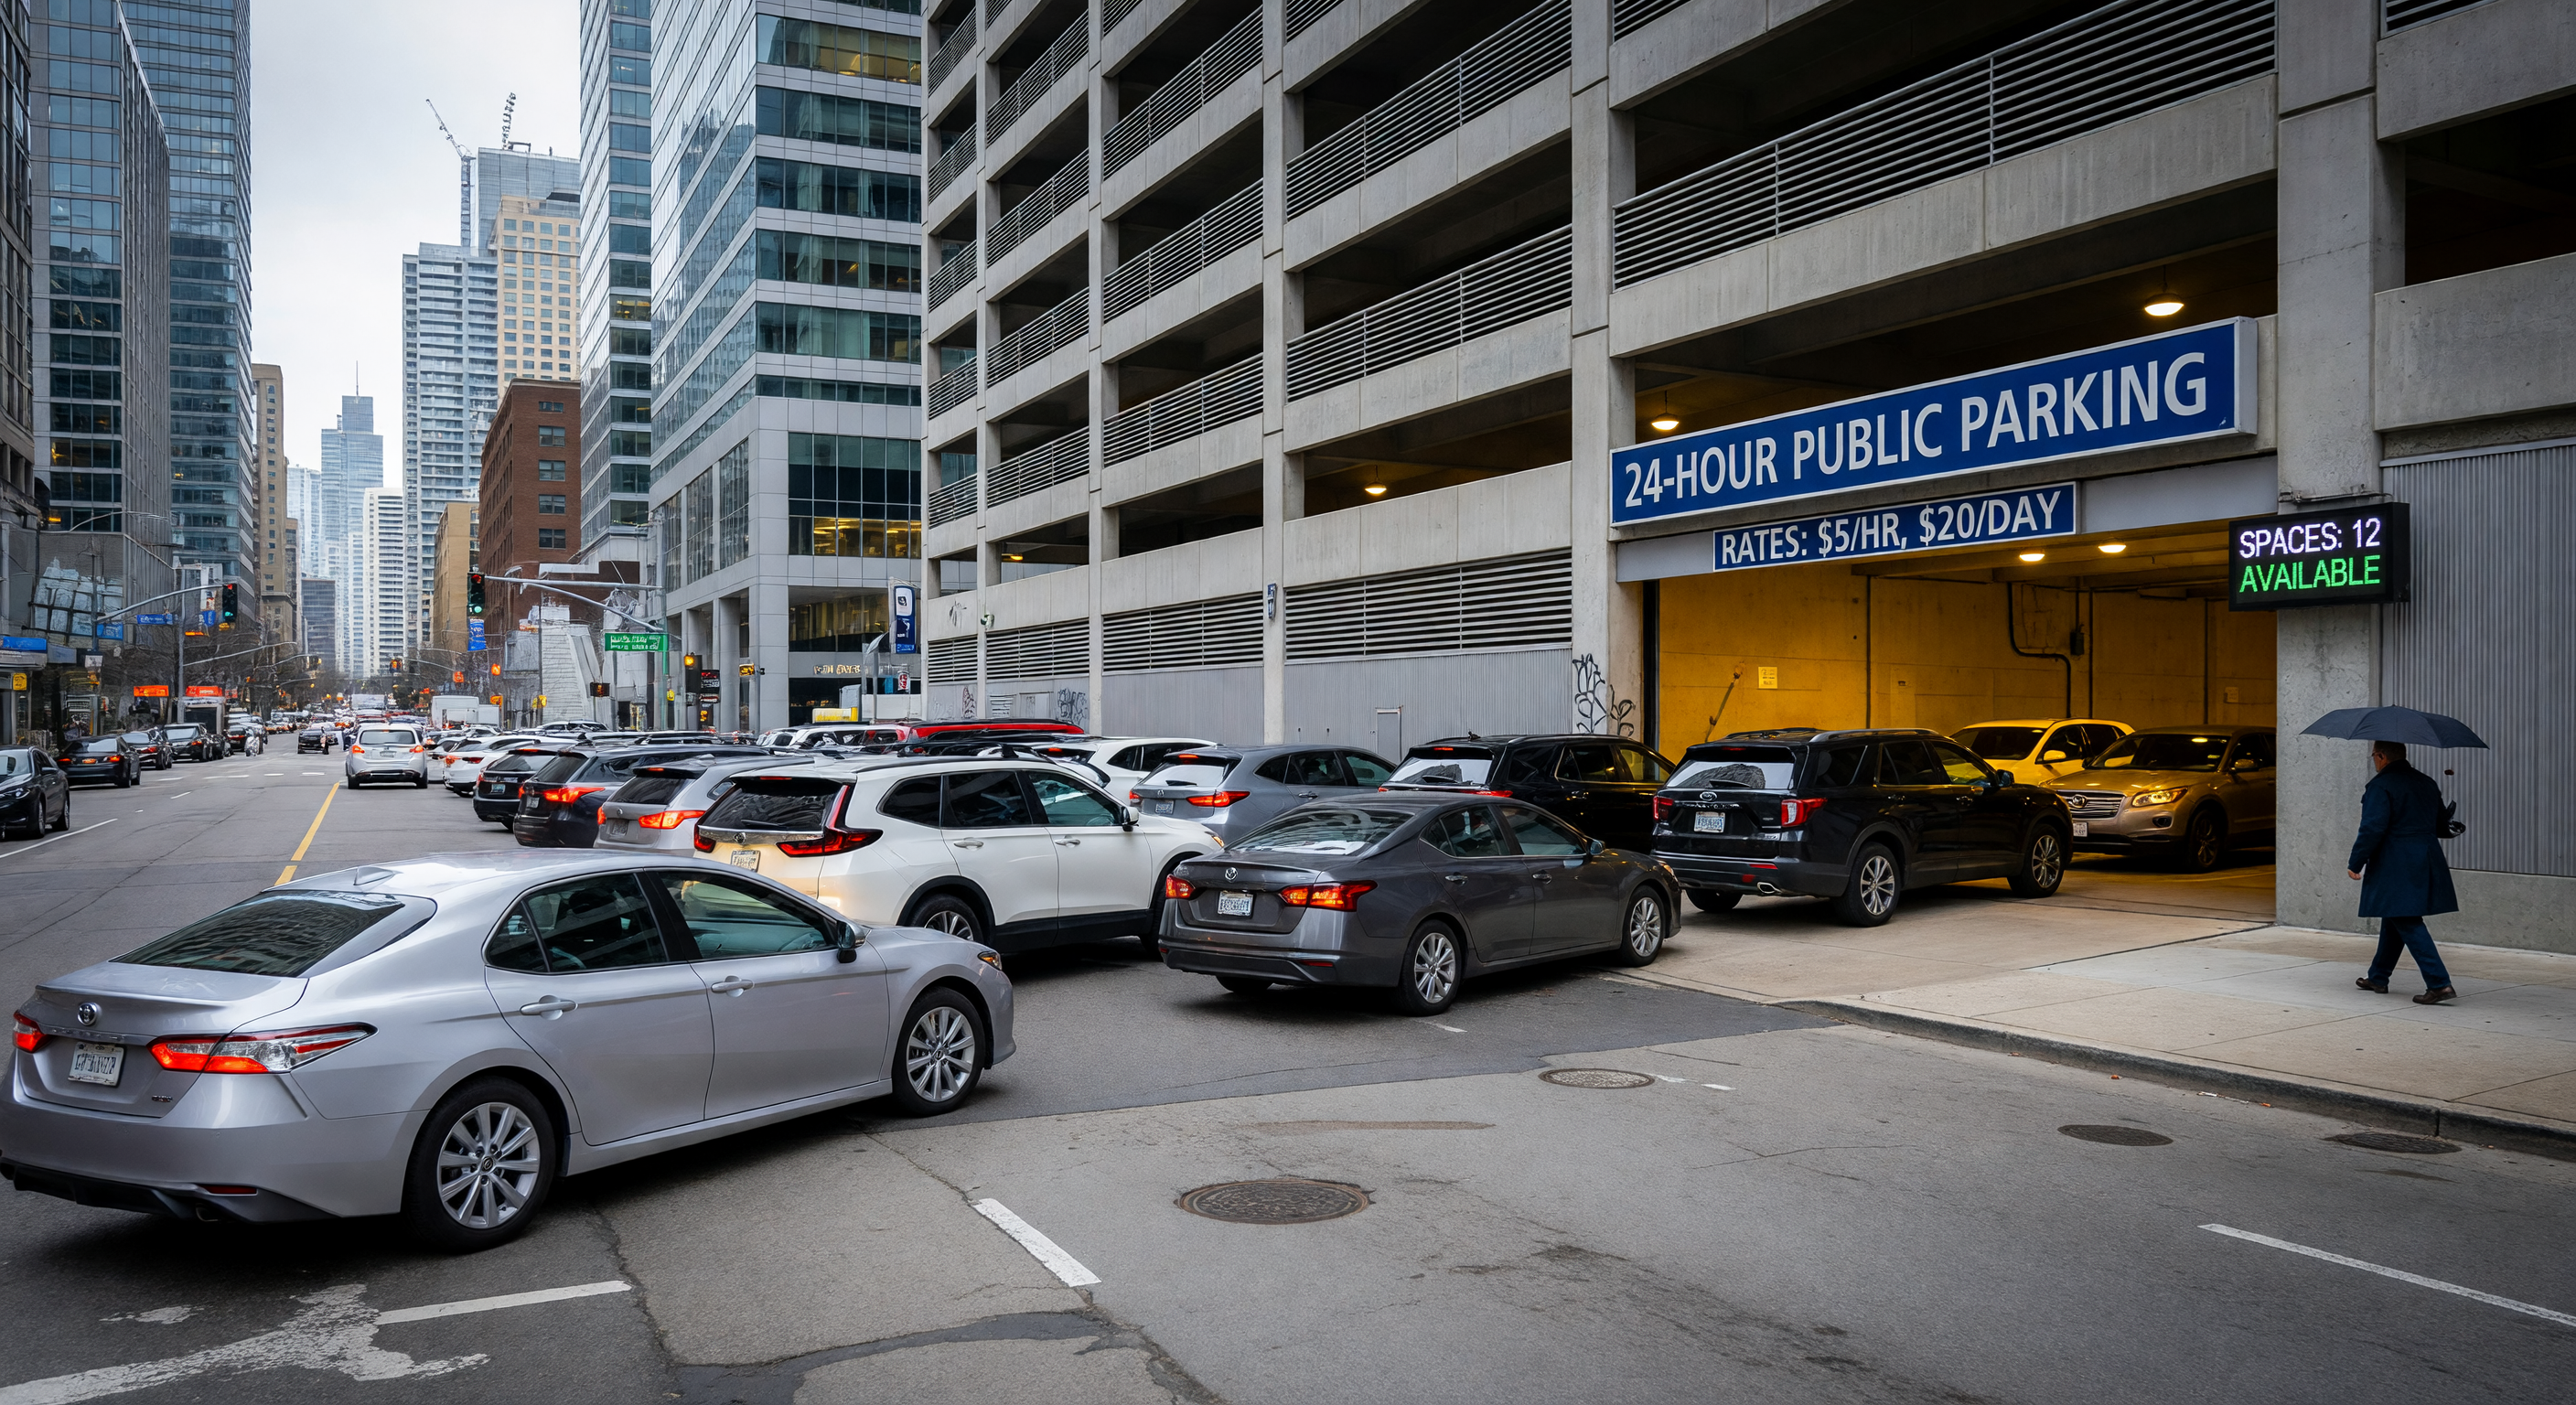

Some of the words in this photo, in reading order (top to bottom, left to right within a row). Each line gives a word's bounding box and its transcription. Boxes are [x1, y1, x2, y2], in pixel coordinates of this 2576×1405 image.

[1625, 436, 1778, 508] 24-HOUR
[1794, 403, 1942, 480] PUBLIC
[1961, 353, 2206, 452] PARKING
[1722, 525, 1808, 565] RATES:
[1819, 512, 1907, 558] $5/HR,
[1919, 491, 2063, 547] $20/DAY
[2238, 521, 2343, 559] SPACES:
[2352, 517, 2381, 549] 12
[2238, 555, 2381, 593] AVAILABLE
